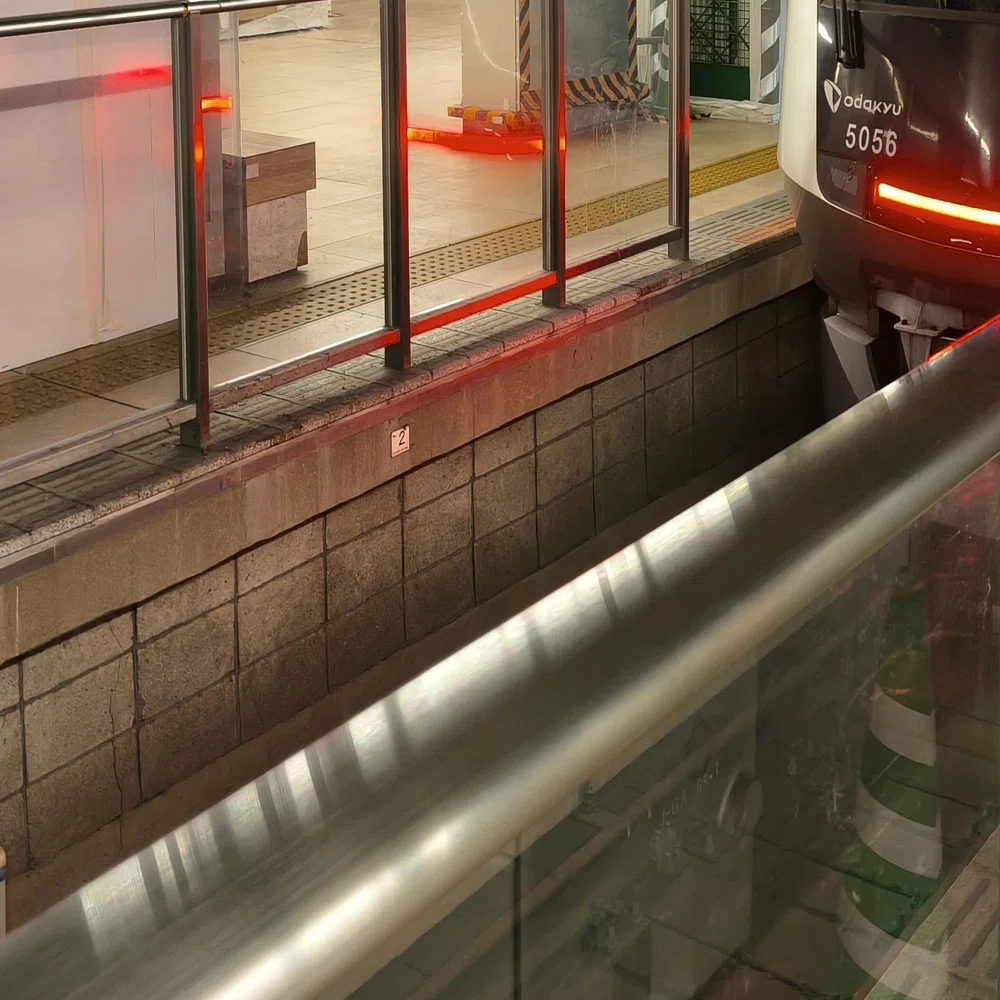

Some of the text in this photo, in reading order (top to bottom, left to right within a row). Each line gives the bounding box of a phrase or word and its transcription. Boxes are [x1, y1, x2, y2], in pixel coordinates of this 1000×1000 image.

[843, 93, 901, 116] odakyu
[845, 123, 898, 157] 5056
[398, 430, 406, 446] 2
